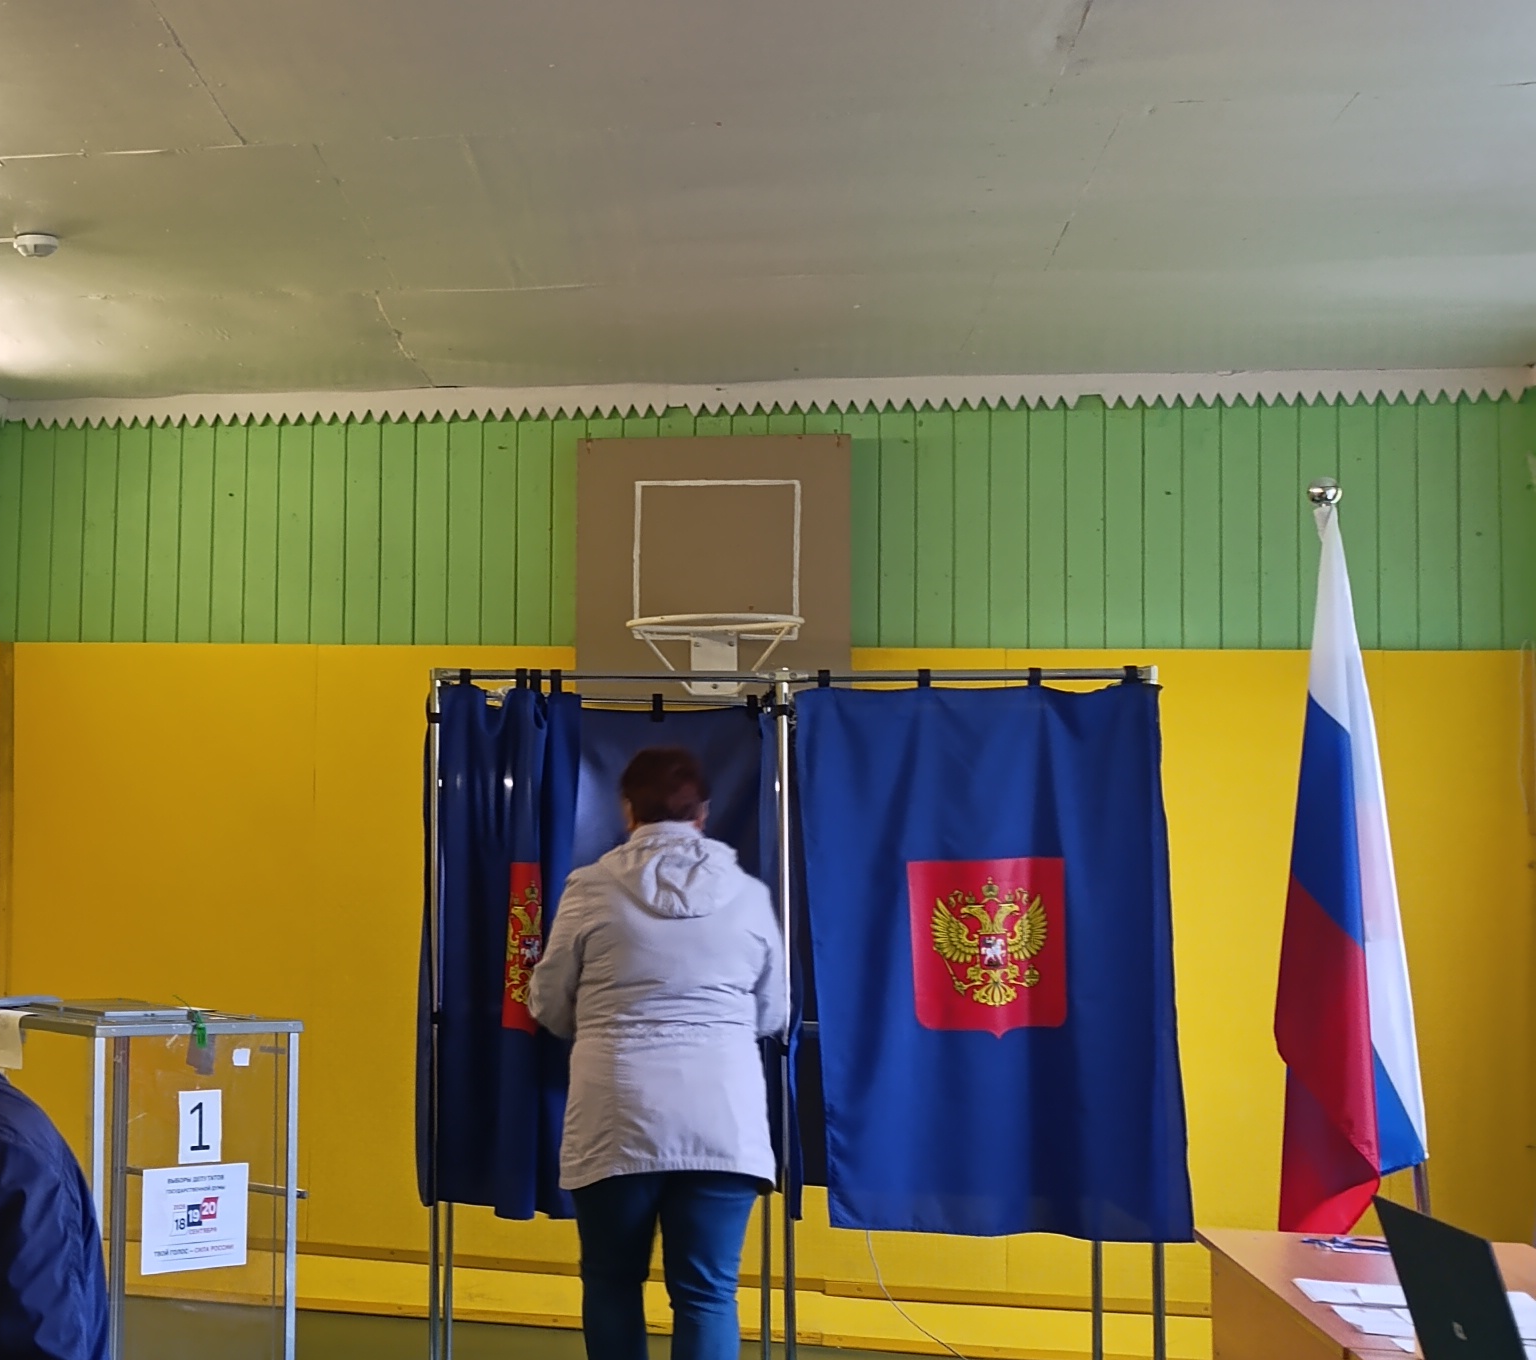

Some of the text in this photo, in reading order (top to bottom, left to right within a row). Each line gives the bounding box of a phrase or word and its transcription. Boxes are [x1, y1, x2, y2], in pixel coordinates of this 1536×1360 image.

[190, 1102, 210, 1151] 1
[201, 1201, 216, 1216] 20
[187, 1209, 200, 1223] 19
[175, 1218, 185, 1230] 18
